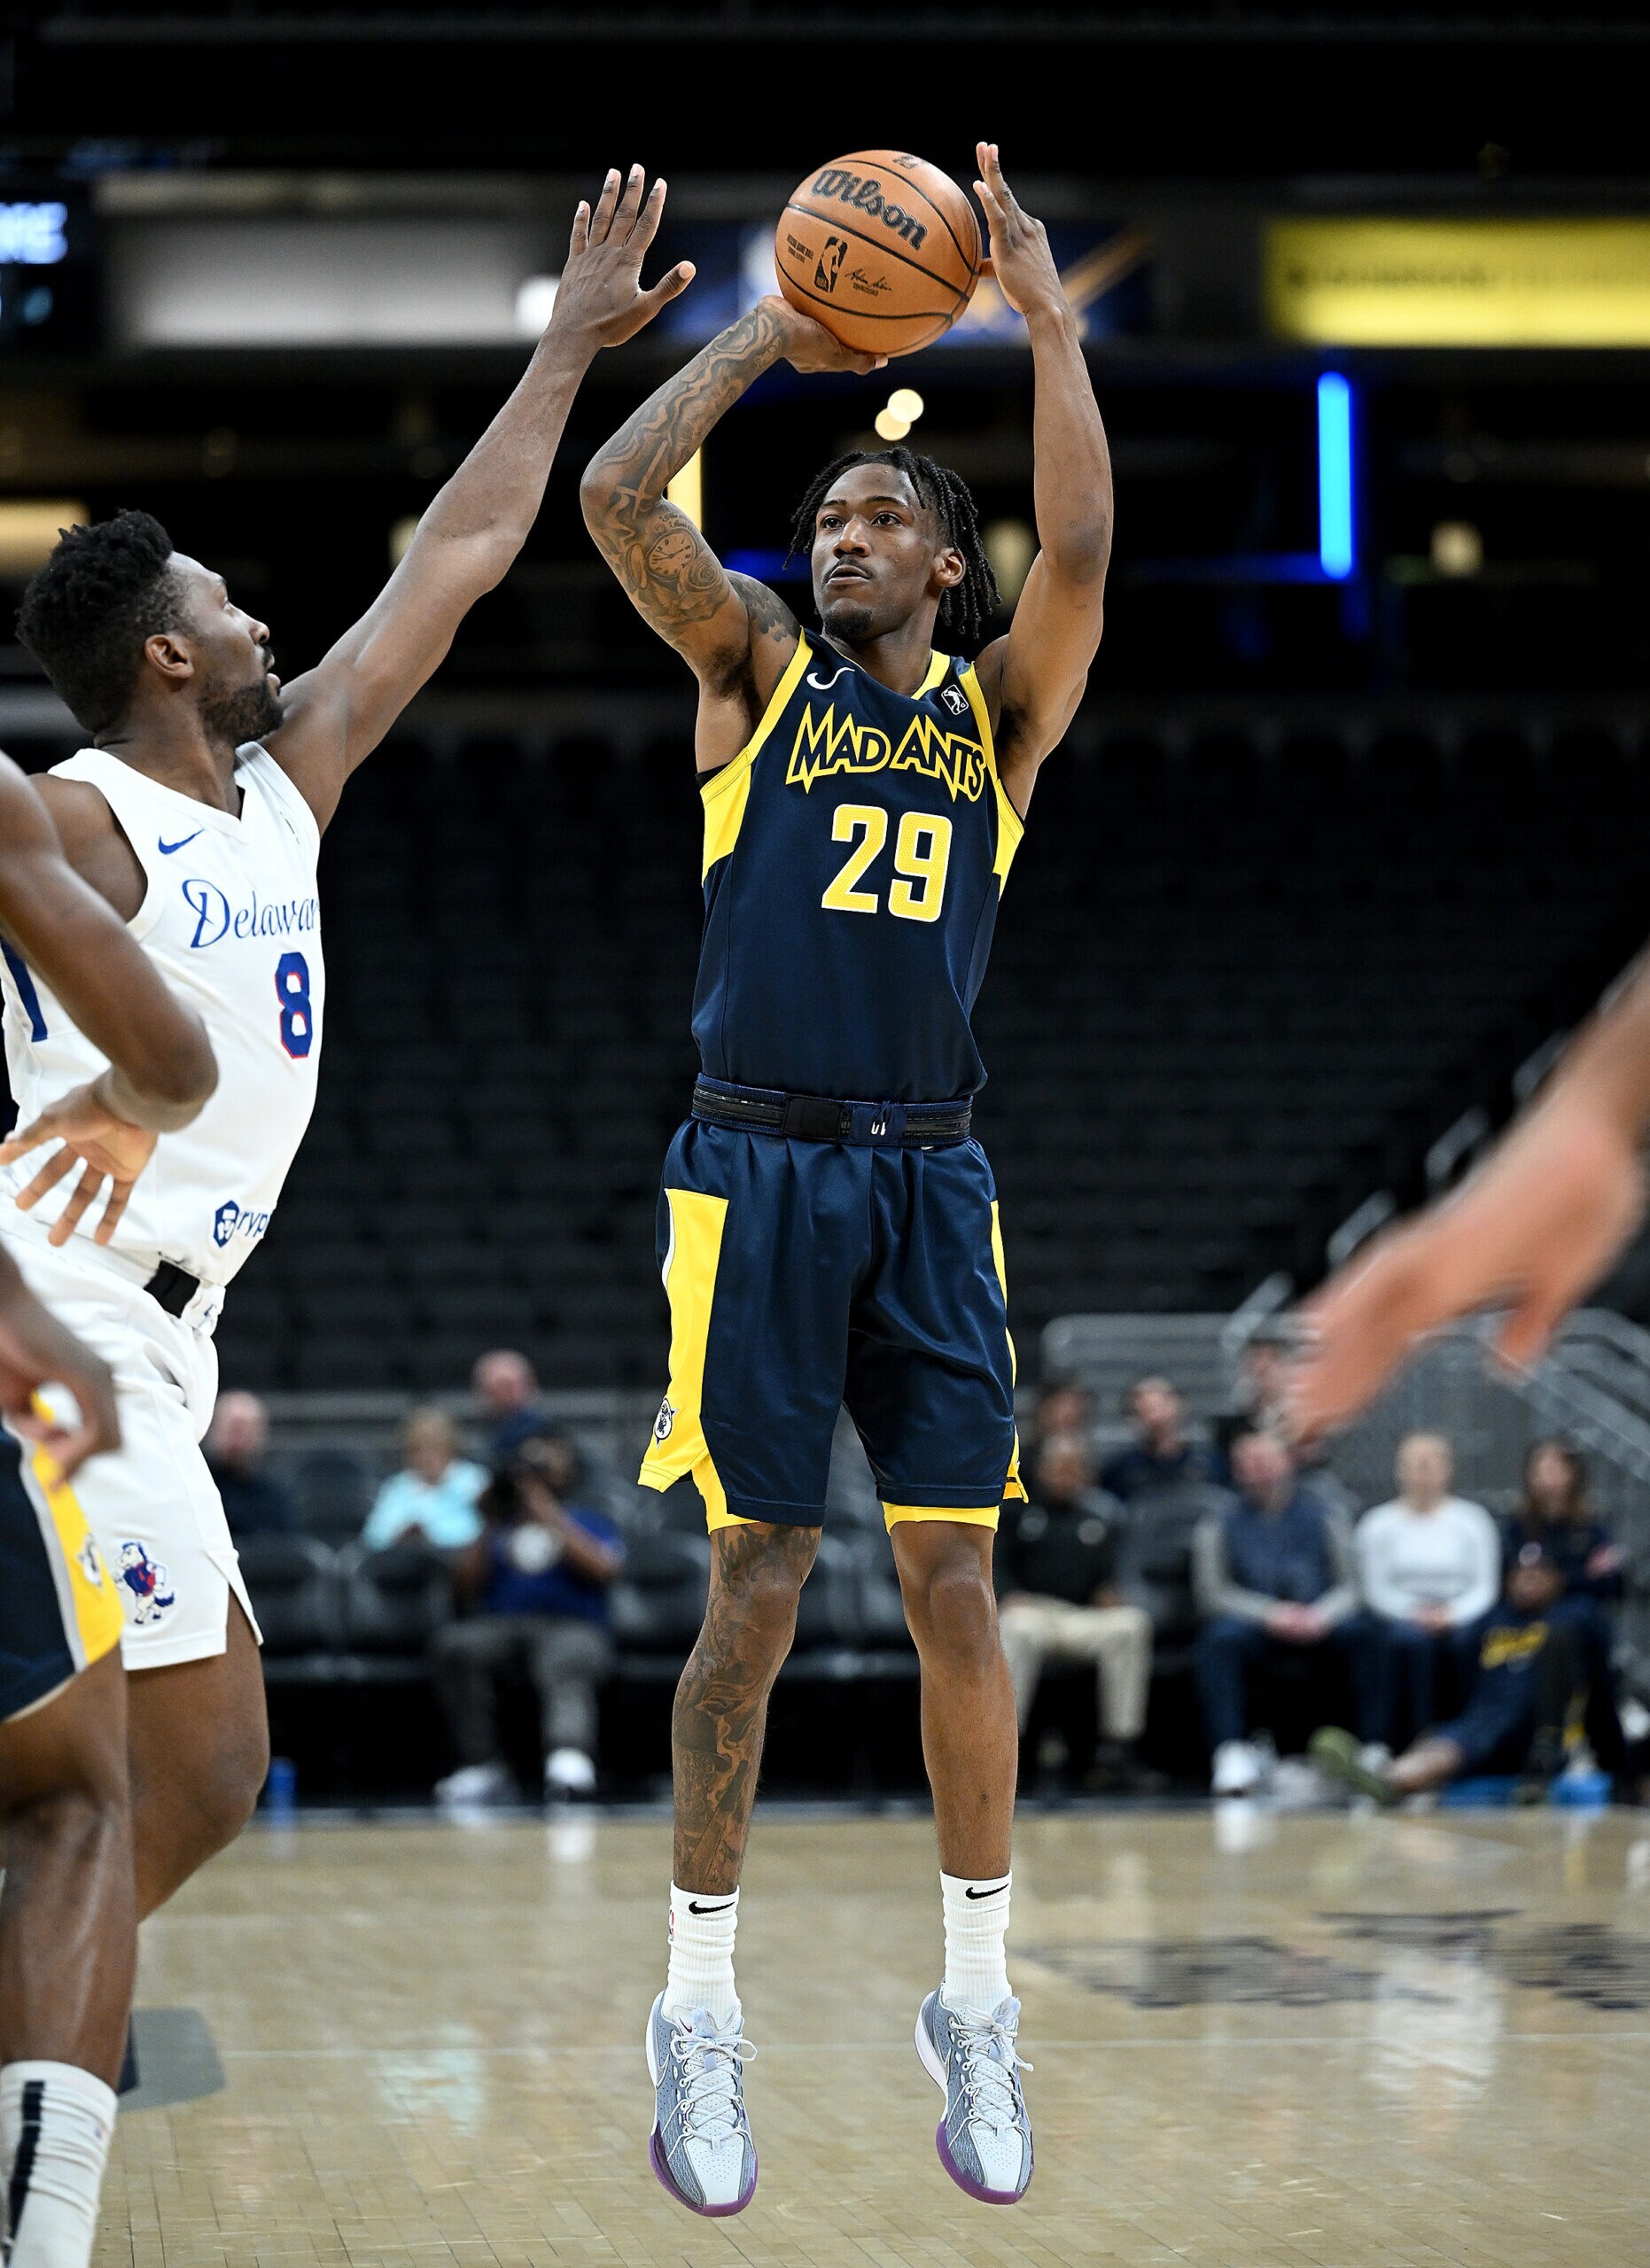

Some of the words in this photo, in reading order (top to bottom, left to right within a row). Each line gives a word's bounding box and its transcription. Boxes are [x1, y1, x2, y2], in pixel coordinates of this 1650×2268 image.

[811, 169, 928, 251] Wilson
[785, 702, 891, 794] MAD
[889, 714, 986, 802] ANTS
[821, 804, 953, 922] 29
[275, 951, 313, 1059] 8
